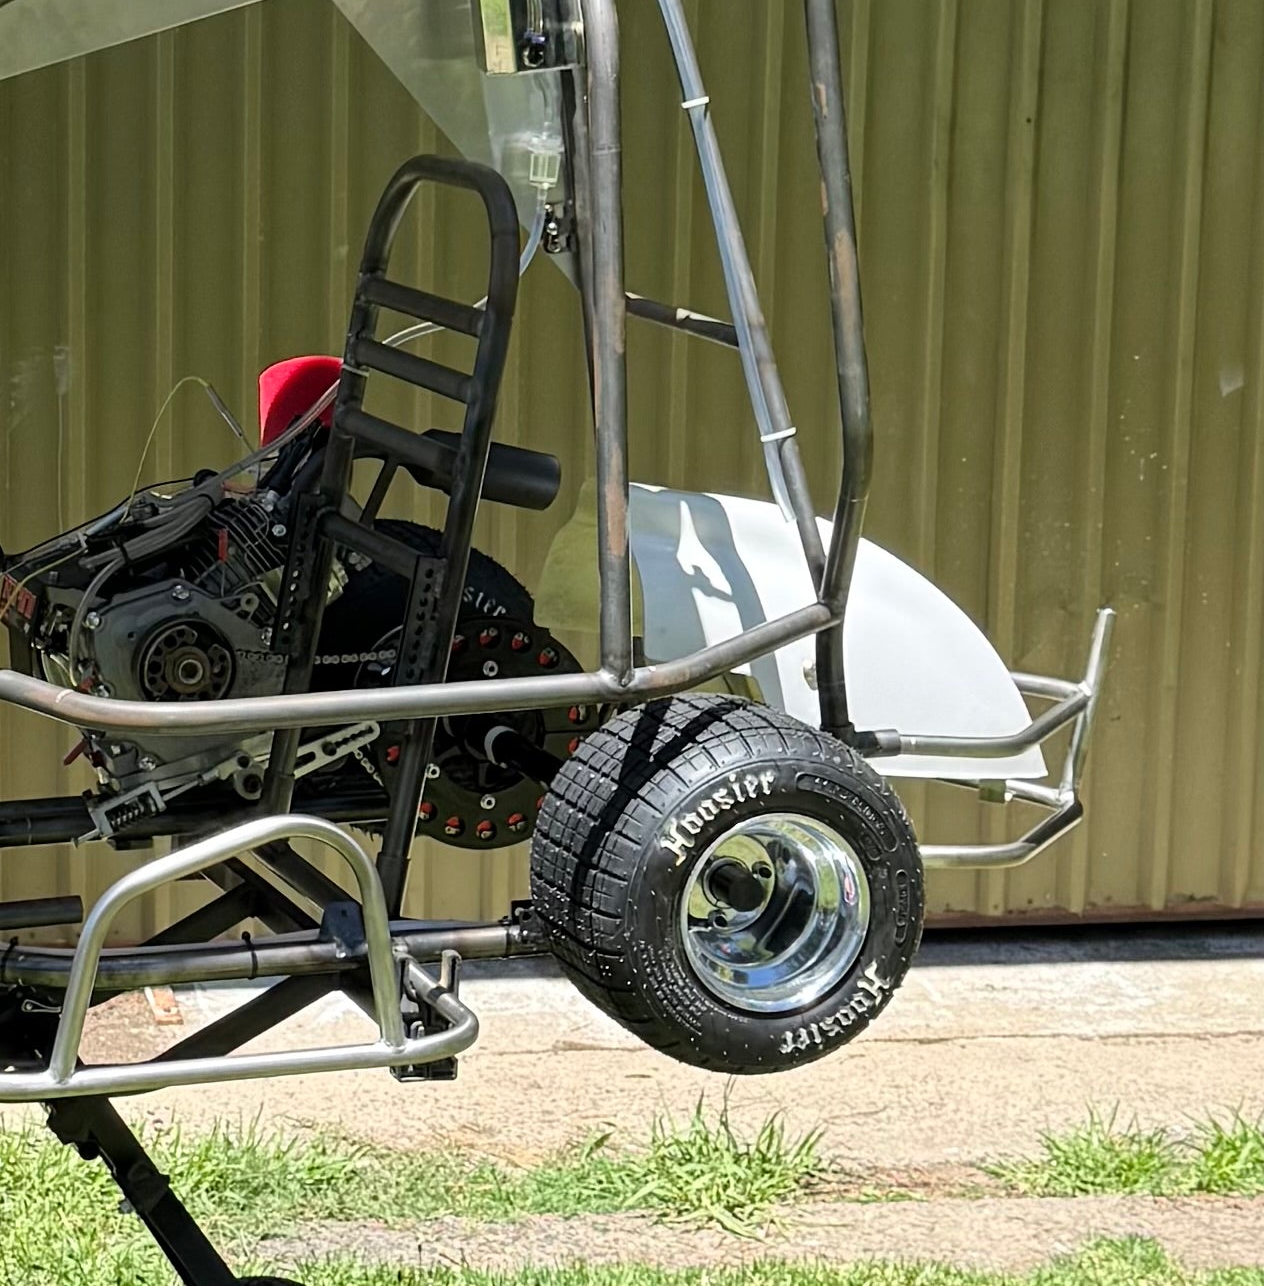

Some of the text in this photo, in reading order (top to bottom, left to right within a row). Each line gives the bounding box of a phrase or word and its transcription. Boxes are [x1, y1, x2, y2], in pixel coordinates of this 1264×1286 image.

[463, 586, 506, 616] sier
[661, 771, 775, 865] Hoosier
[780, 960, 891, 1055] Hoosier
